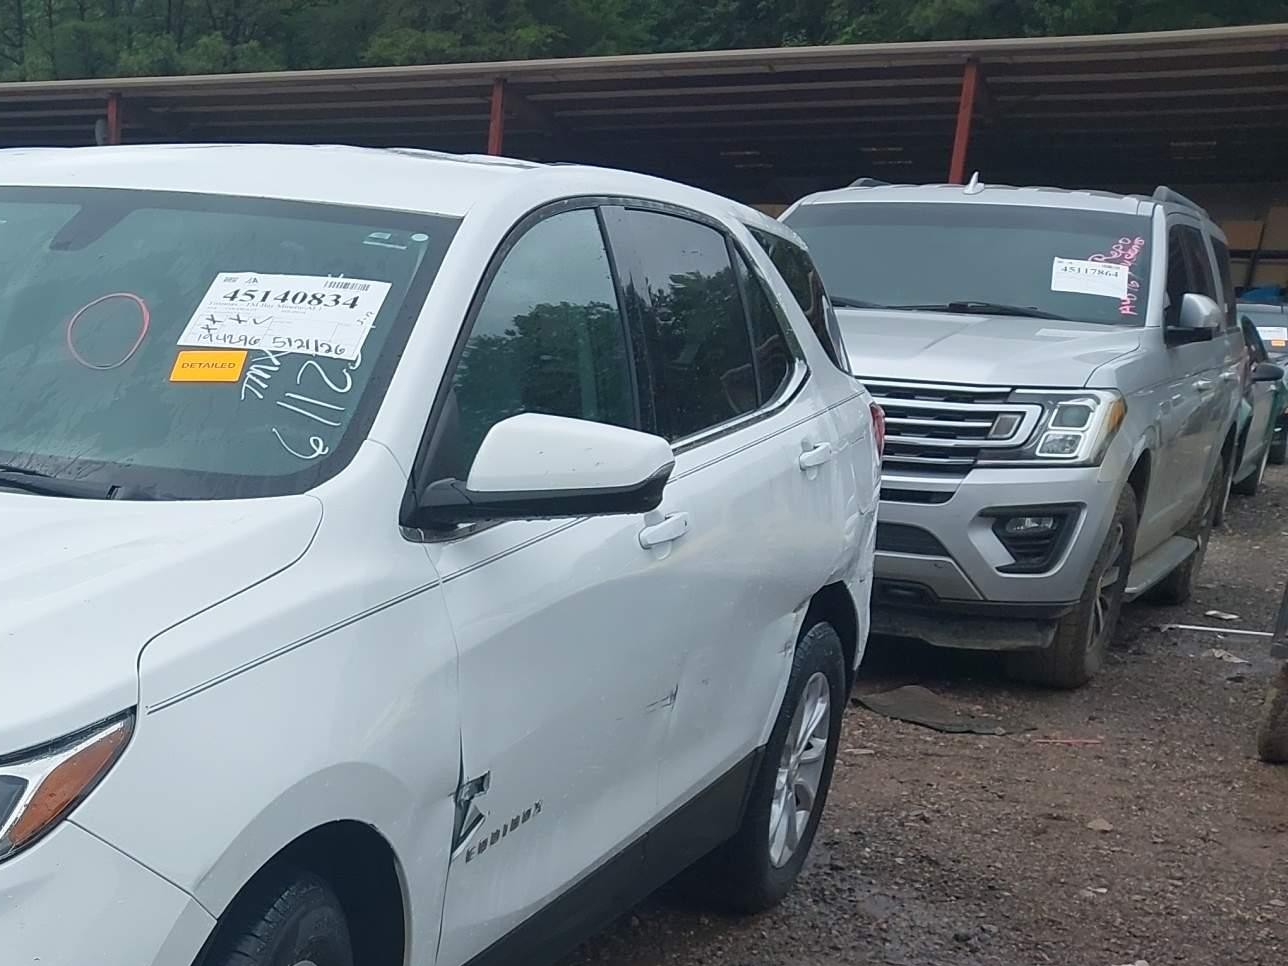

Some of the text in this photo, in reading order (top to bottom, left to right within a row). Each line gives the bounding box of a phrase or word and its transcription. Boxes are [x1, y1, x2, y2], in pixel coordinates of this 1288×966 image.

[1061, 266, 1119, 278] 45117864
[222, 288, 361, 309] 45140834
[181, 361, 237, 370] DETAILED
